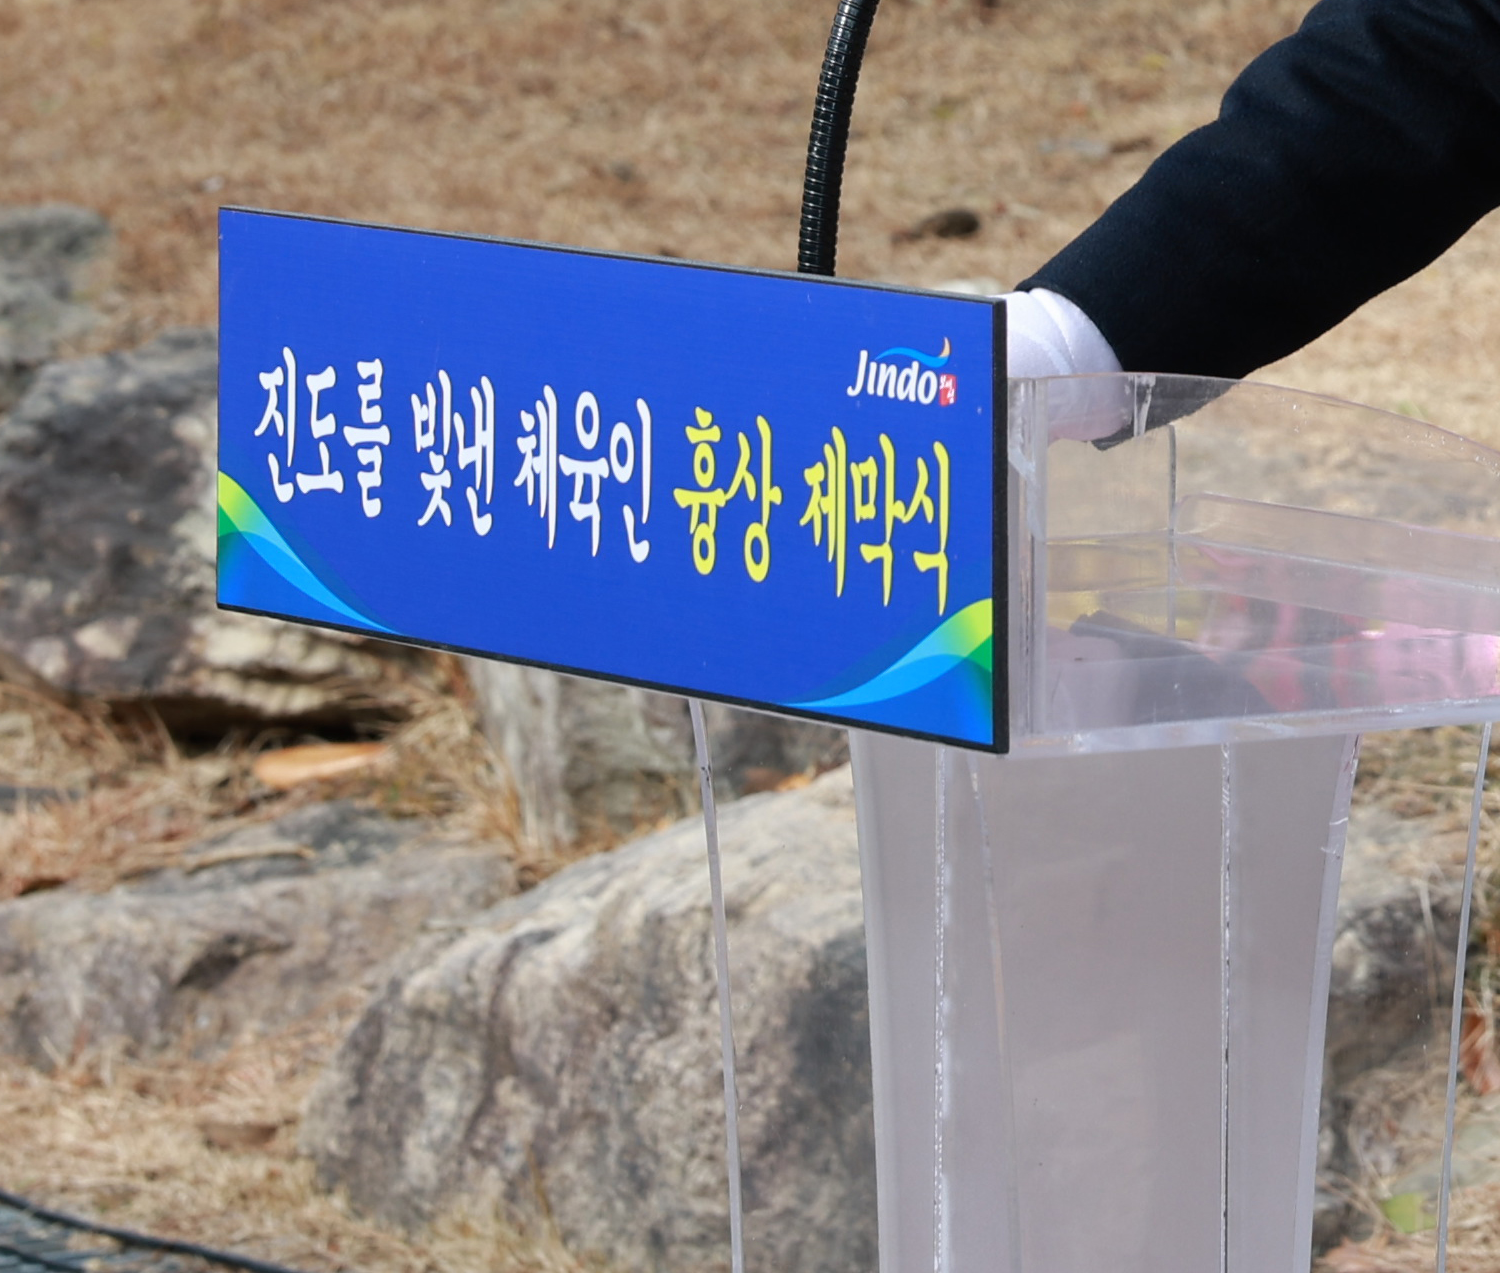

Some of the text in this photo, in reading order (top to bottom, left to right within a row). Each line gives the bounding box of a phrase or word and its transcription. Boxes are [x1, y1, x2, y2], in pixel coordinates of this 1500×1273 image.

[846, 349, 938, 405] Jindo
[253, 346, 950, 616] 진도를 빛낸 체육인 흉상 제막식
